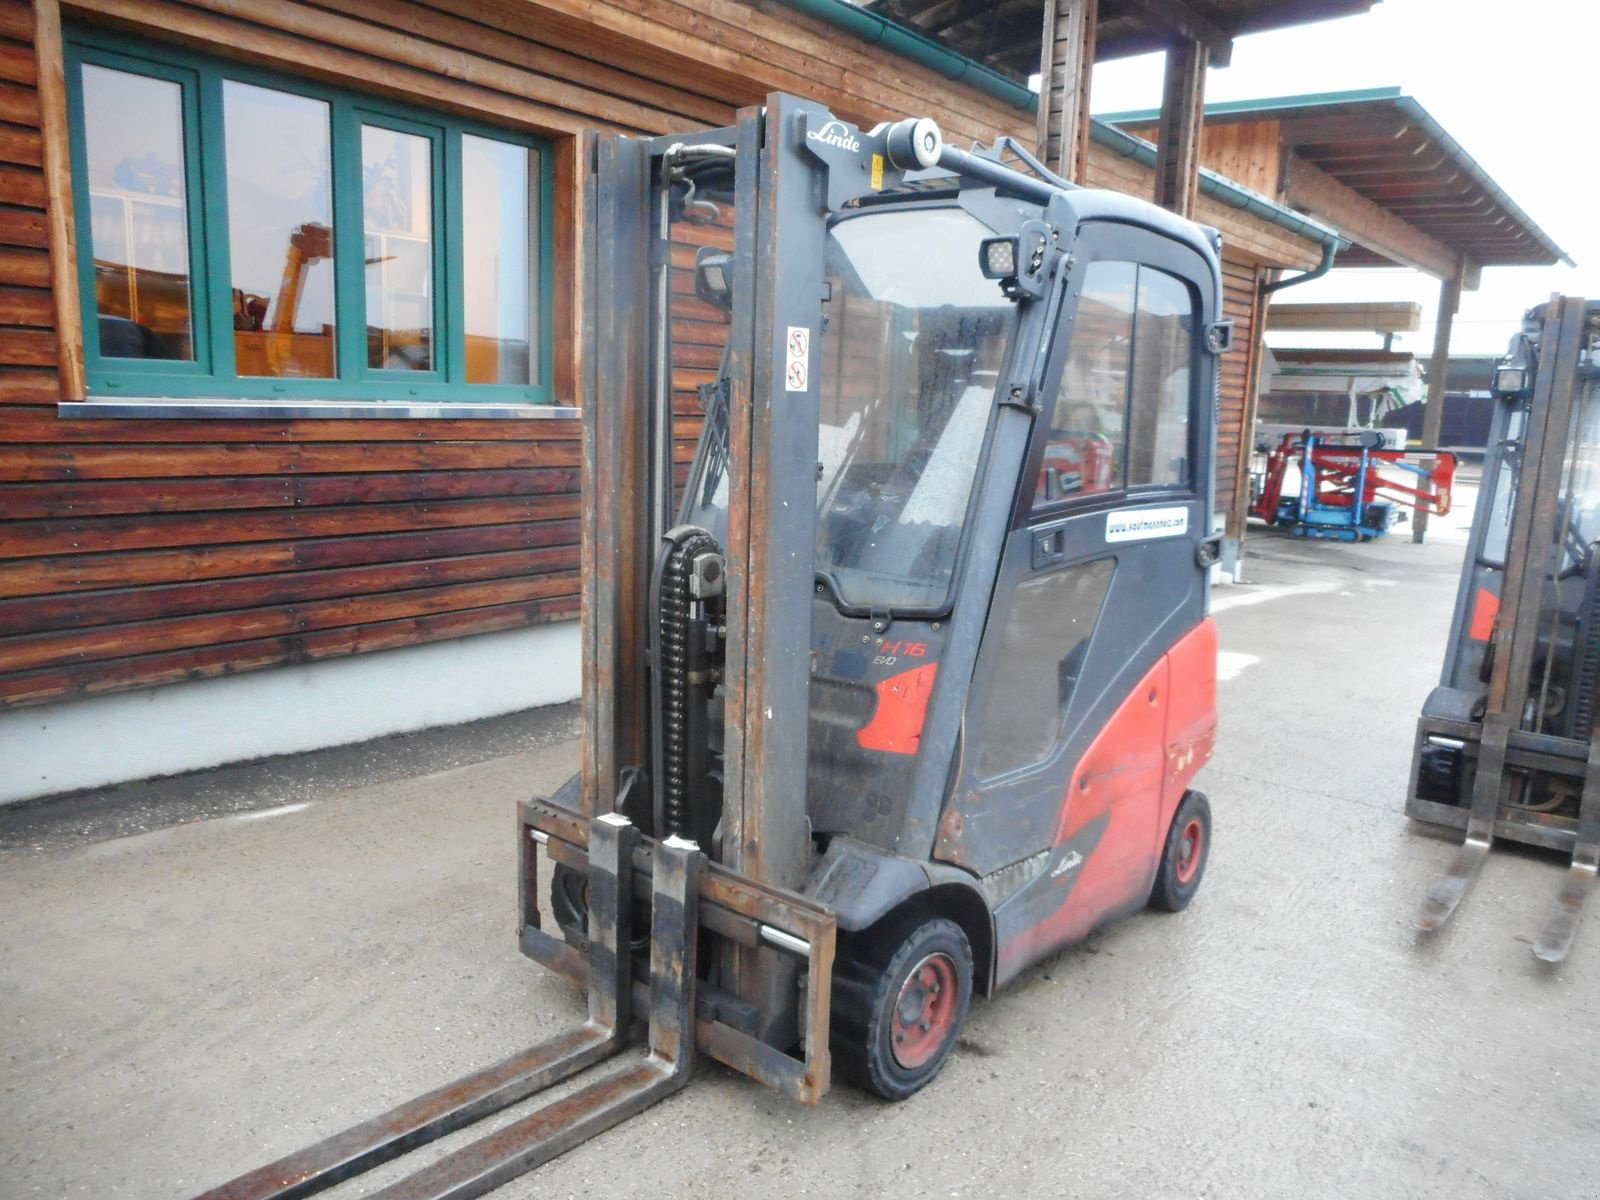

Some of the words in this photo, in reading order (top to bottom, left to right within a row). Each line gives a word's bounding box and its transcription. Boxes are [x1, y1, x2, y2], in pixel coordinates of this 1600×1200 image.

[807, 121, 860, 153] Linde
[880, 640, 903, 655] H
[903, 641, 929, 657] 16
[873, 655, 897, 666] EVO
